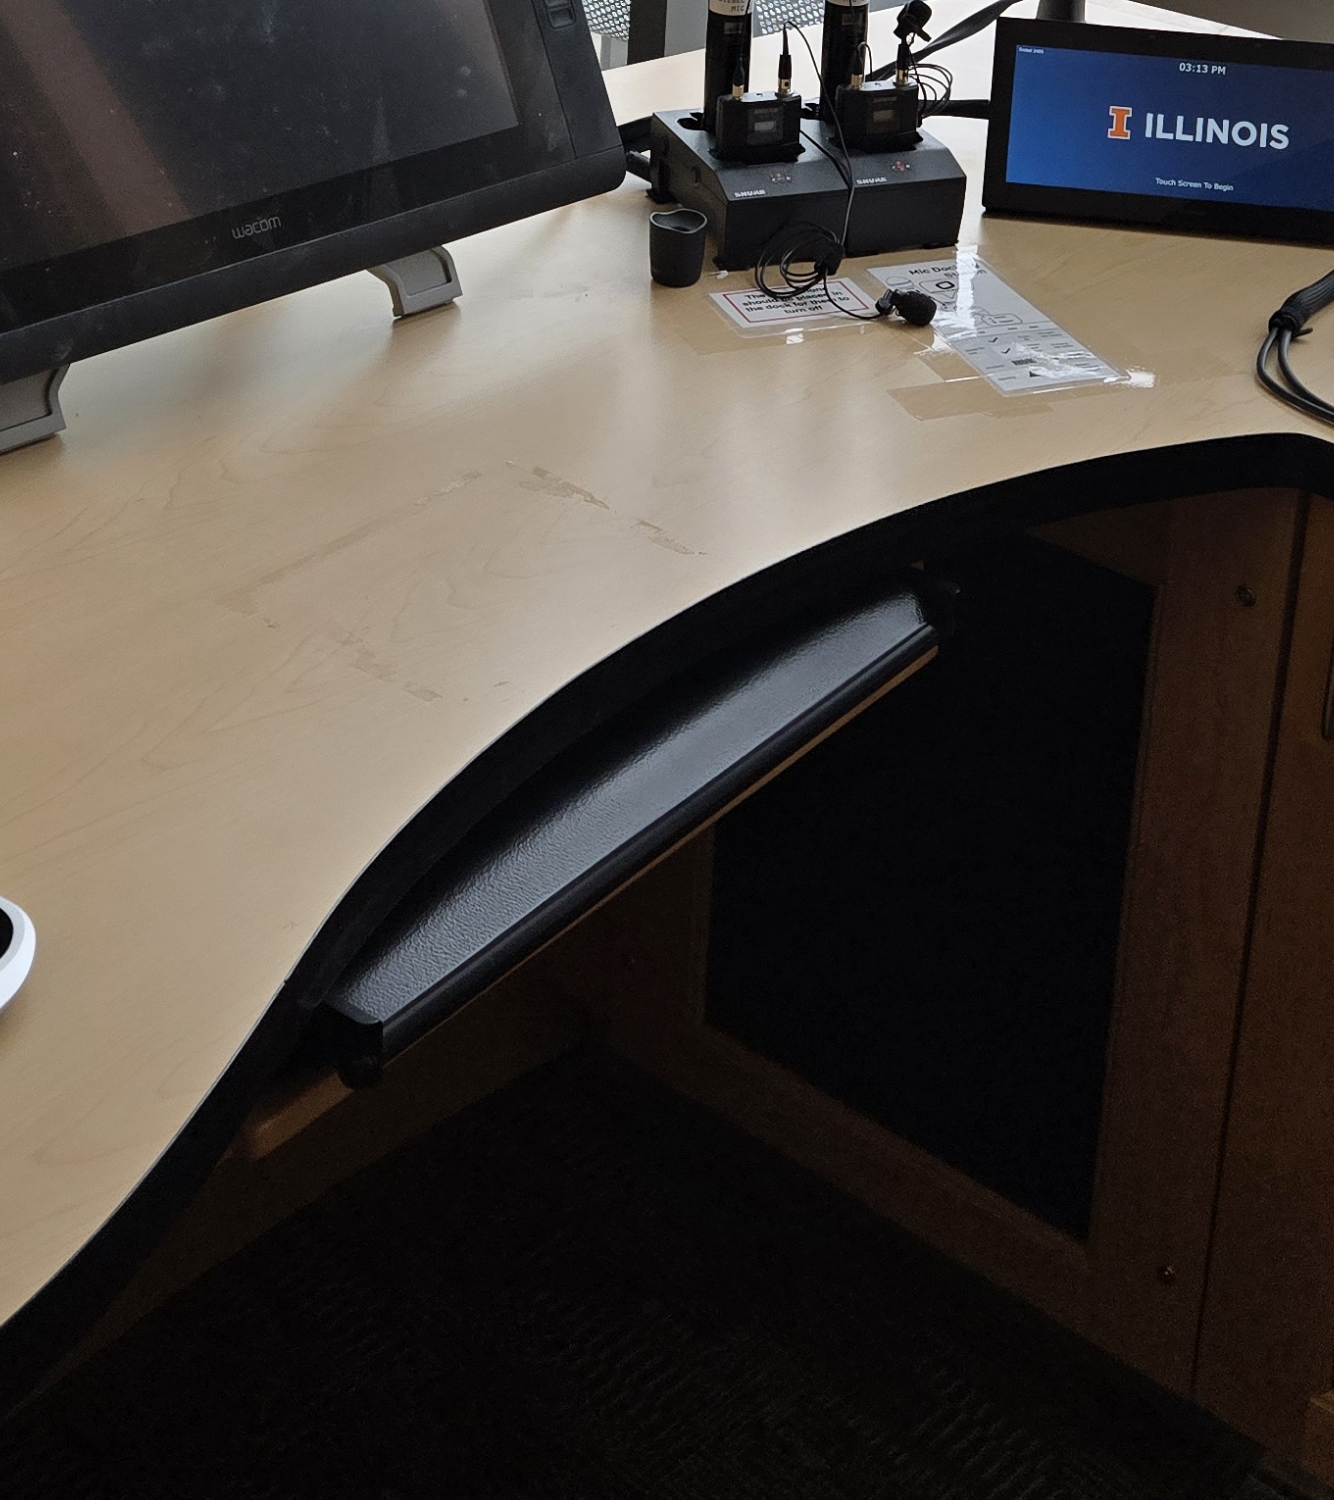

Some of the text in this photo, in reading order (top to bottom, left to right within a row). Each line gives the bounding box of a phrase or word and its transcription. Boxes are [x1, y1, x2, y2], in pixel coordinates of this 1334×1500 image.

[1179, 62, 1226, 75] 03:13 PM
[1145, 113, 1290, 150] ILLINOIS
[1155, 177, 1234, 192] Touch Screen To Begin
[231, 215, 283, 239] wacom
[908, 267, 931, 276] Mic
[742, 296, 778, 306] should
[745, 305, 763, 313] the
[784, 307, 806, 315] turn
